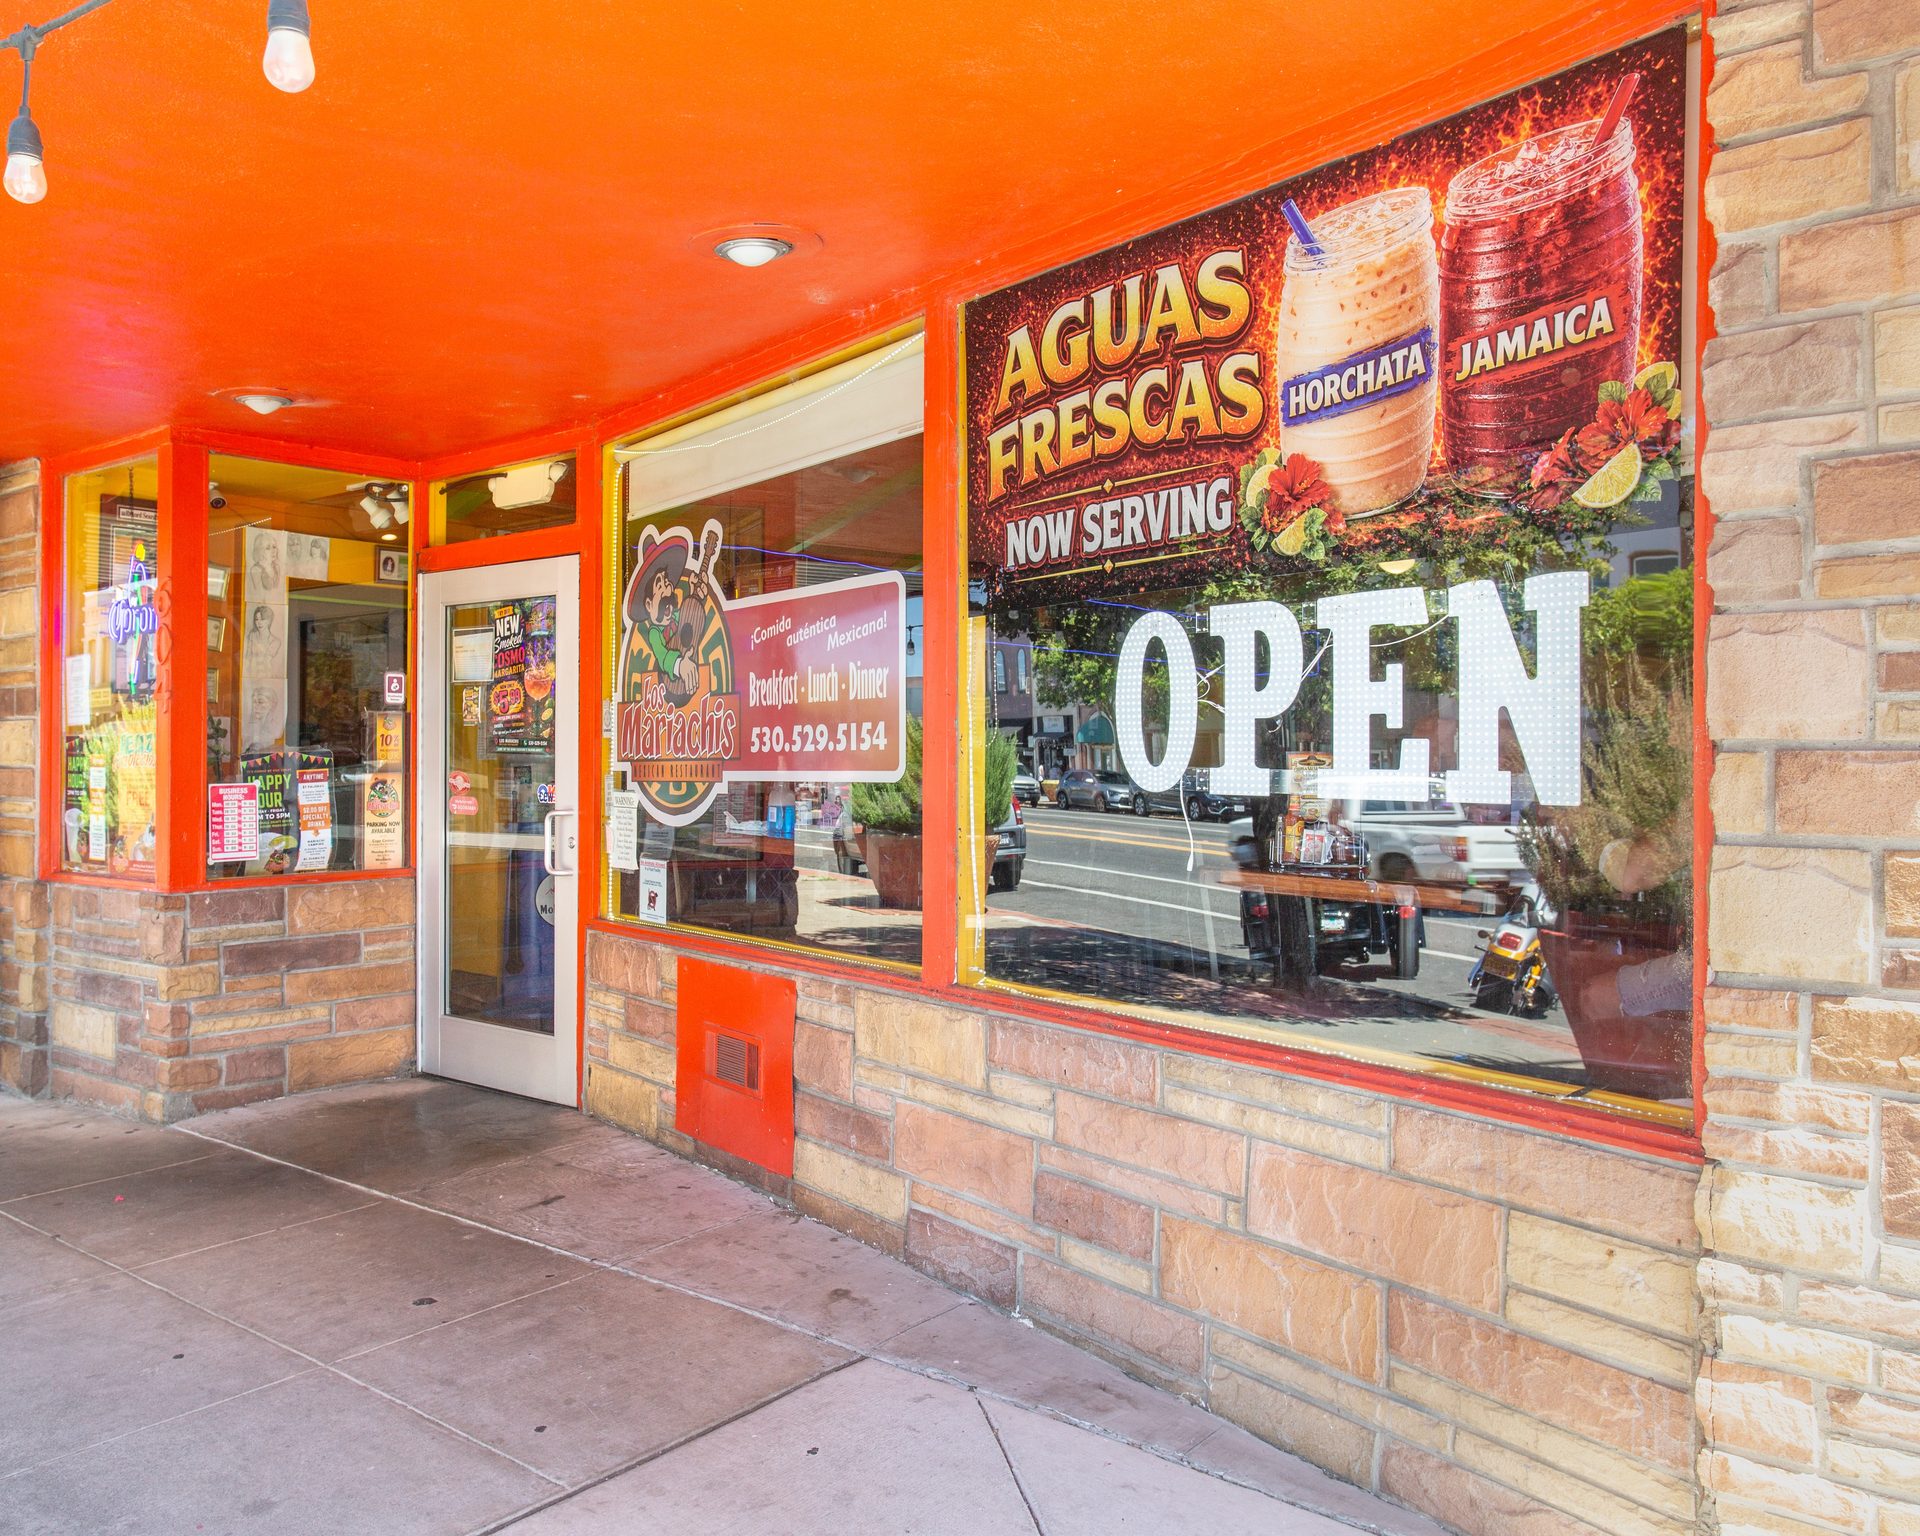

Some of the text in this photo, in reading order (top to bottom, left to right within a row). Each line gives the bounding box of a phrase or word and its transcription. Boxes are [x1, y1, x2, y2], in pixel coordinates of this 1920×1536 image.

[995, 248, 1252, 416] AGUAS
[1456, 297, 1614, 382] JAMAICA
[1288, 342, 1426, 417] HORCHATA
[988, 352, 1265, 502] FRESCAS
[1006, 477, 1233, 568] NOW SERVING
[109, 599, 158, 643] Coron
[494, 628, 523, 653] Smoked
[496, 614, 520, 637] NEW
[751, 610, 888, 651] ¡Comida auténtica Mexicana!
[493, 688, 521, 713] $5.99
[644, 676, 666, 714] Los
[749, 660, 889, 710] Breakfast Lunch Dinner
[1115, 571, 1589, 806] OPEN
[621, 692, 736, 760] Mariachis
[750, 720, 887, 753] 530.529.5154
[633, 764, 720, 778] MEXICAN RESTAURANT
[258, 792, 282, 808] OUR
[540, 904, 554, 915] Mo
